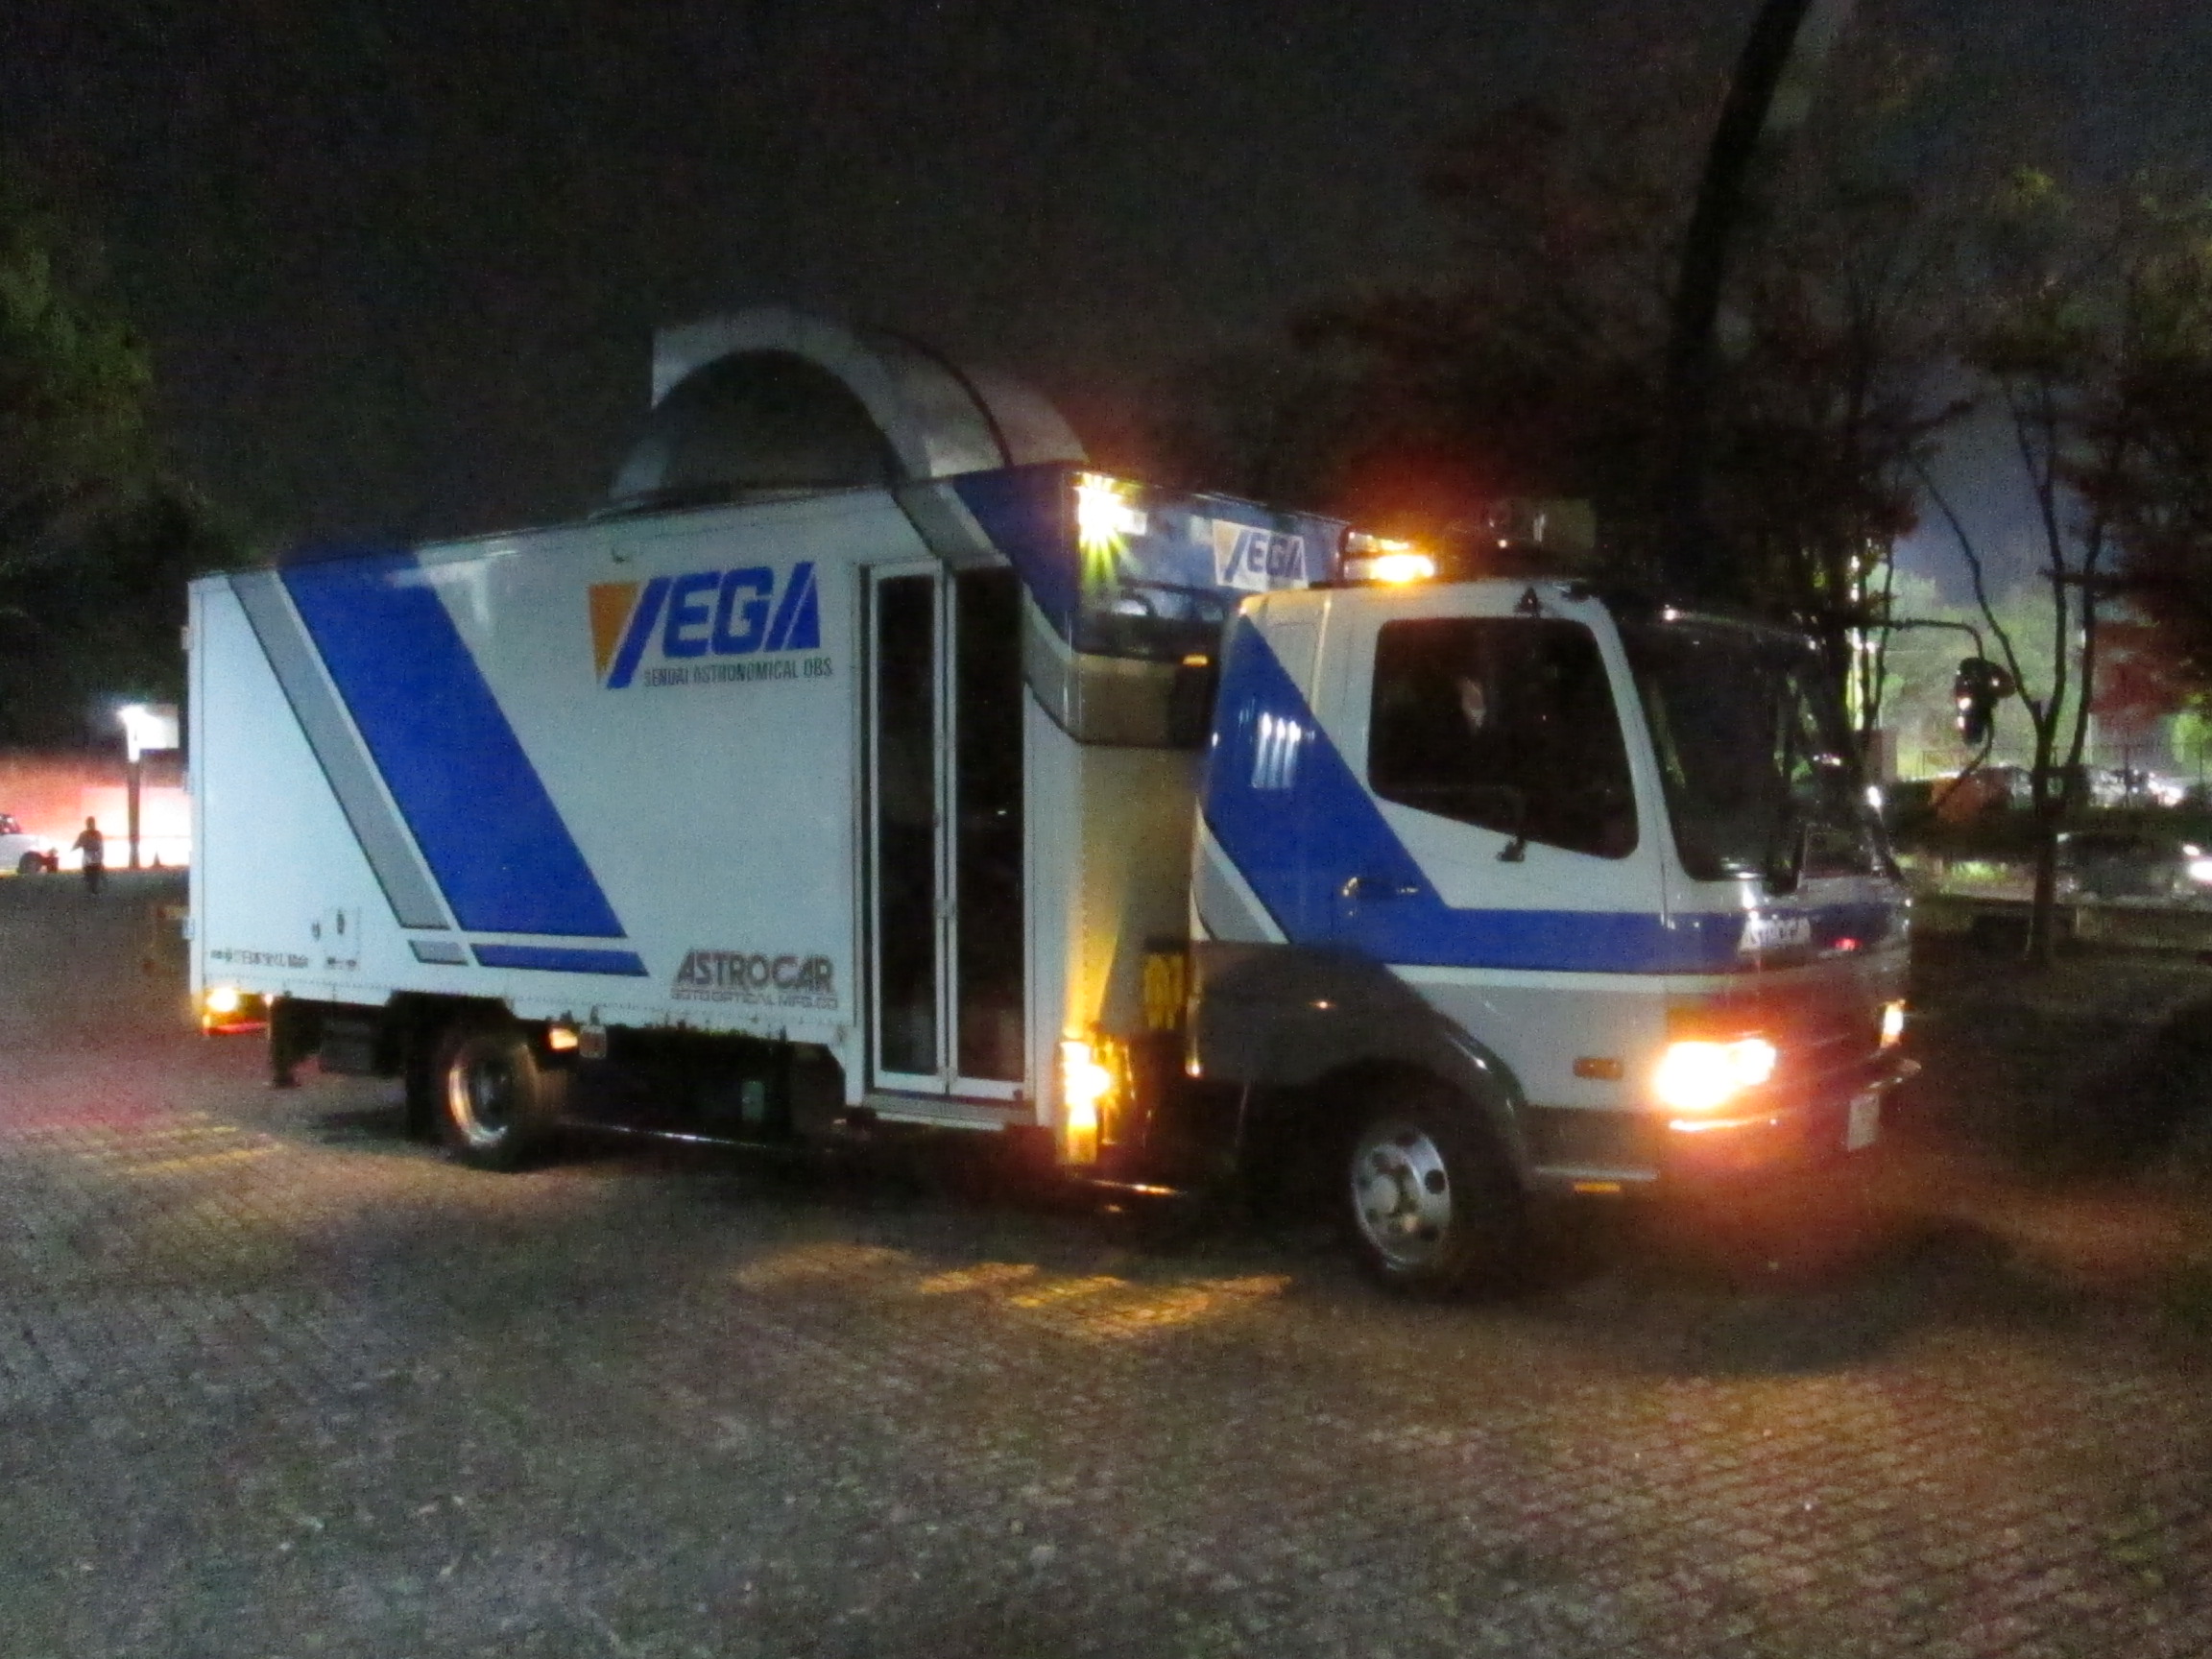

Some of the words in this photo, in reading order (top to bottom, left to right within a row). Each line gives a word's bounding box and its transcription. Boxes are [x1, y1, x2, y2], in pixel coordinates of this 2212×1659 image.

[1213, 524, 1304, 582] VEGA
[588, 561, 821, 690] VEGA
[644, 666, 689, 687] SENDAI
[694, 660, 799, 684] ASTRONOMICAL
[675, 949, 834, 993] ASTROCAR
